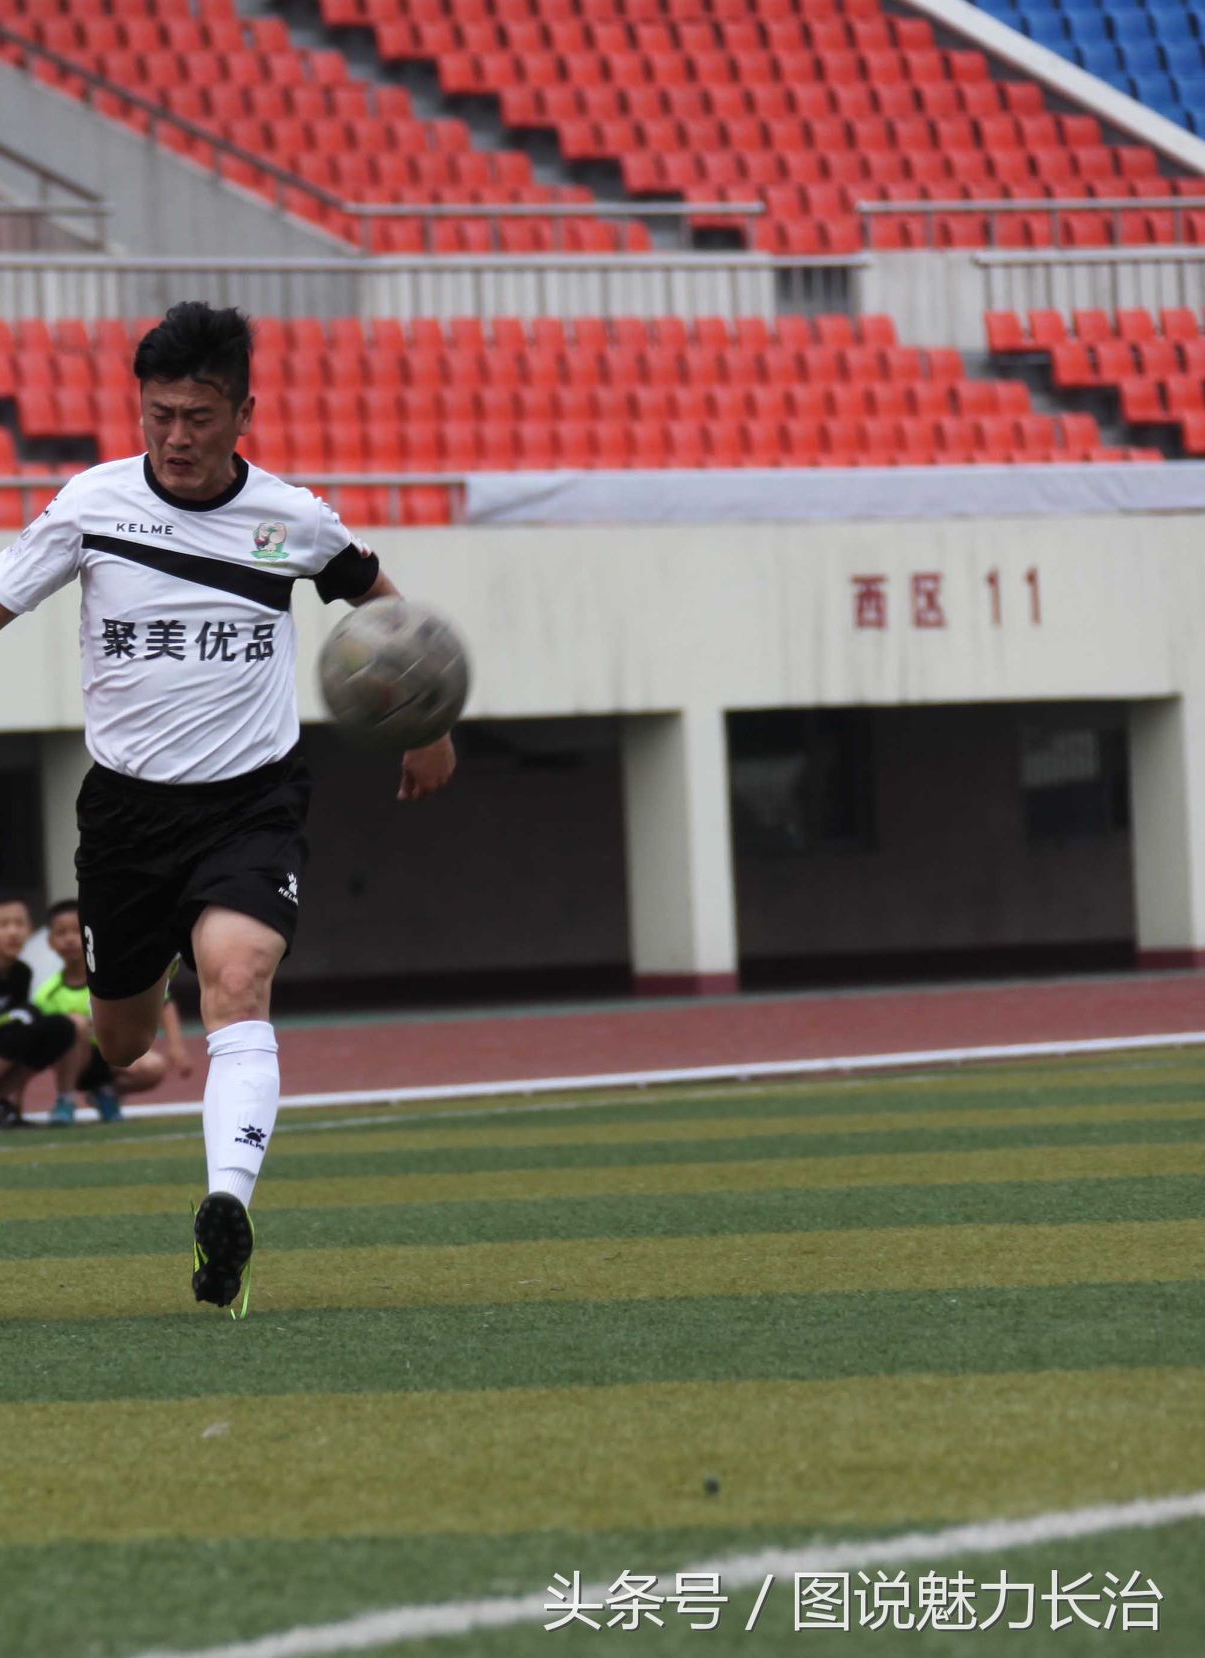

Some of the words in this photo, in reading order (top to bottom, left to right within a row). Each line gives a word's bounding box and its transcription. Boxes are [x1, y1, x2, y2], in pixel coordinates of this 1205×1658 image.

[115, 522, 174, 536] KELME
[850, 573, 947, 629] 西区
[985, 566, 1042, 626] 11
[101, 617, 276, 663] 聚美优品
